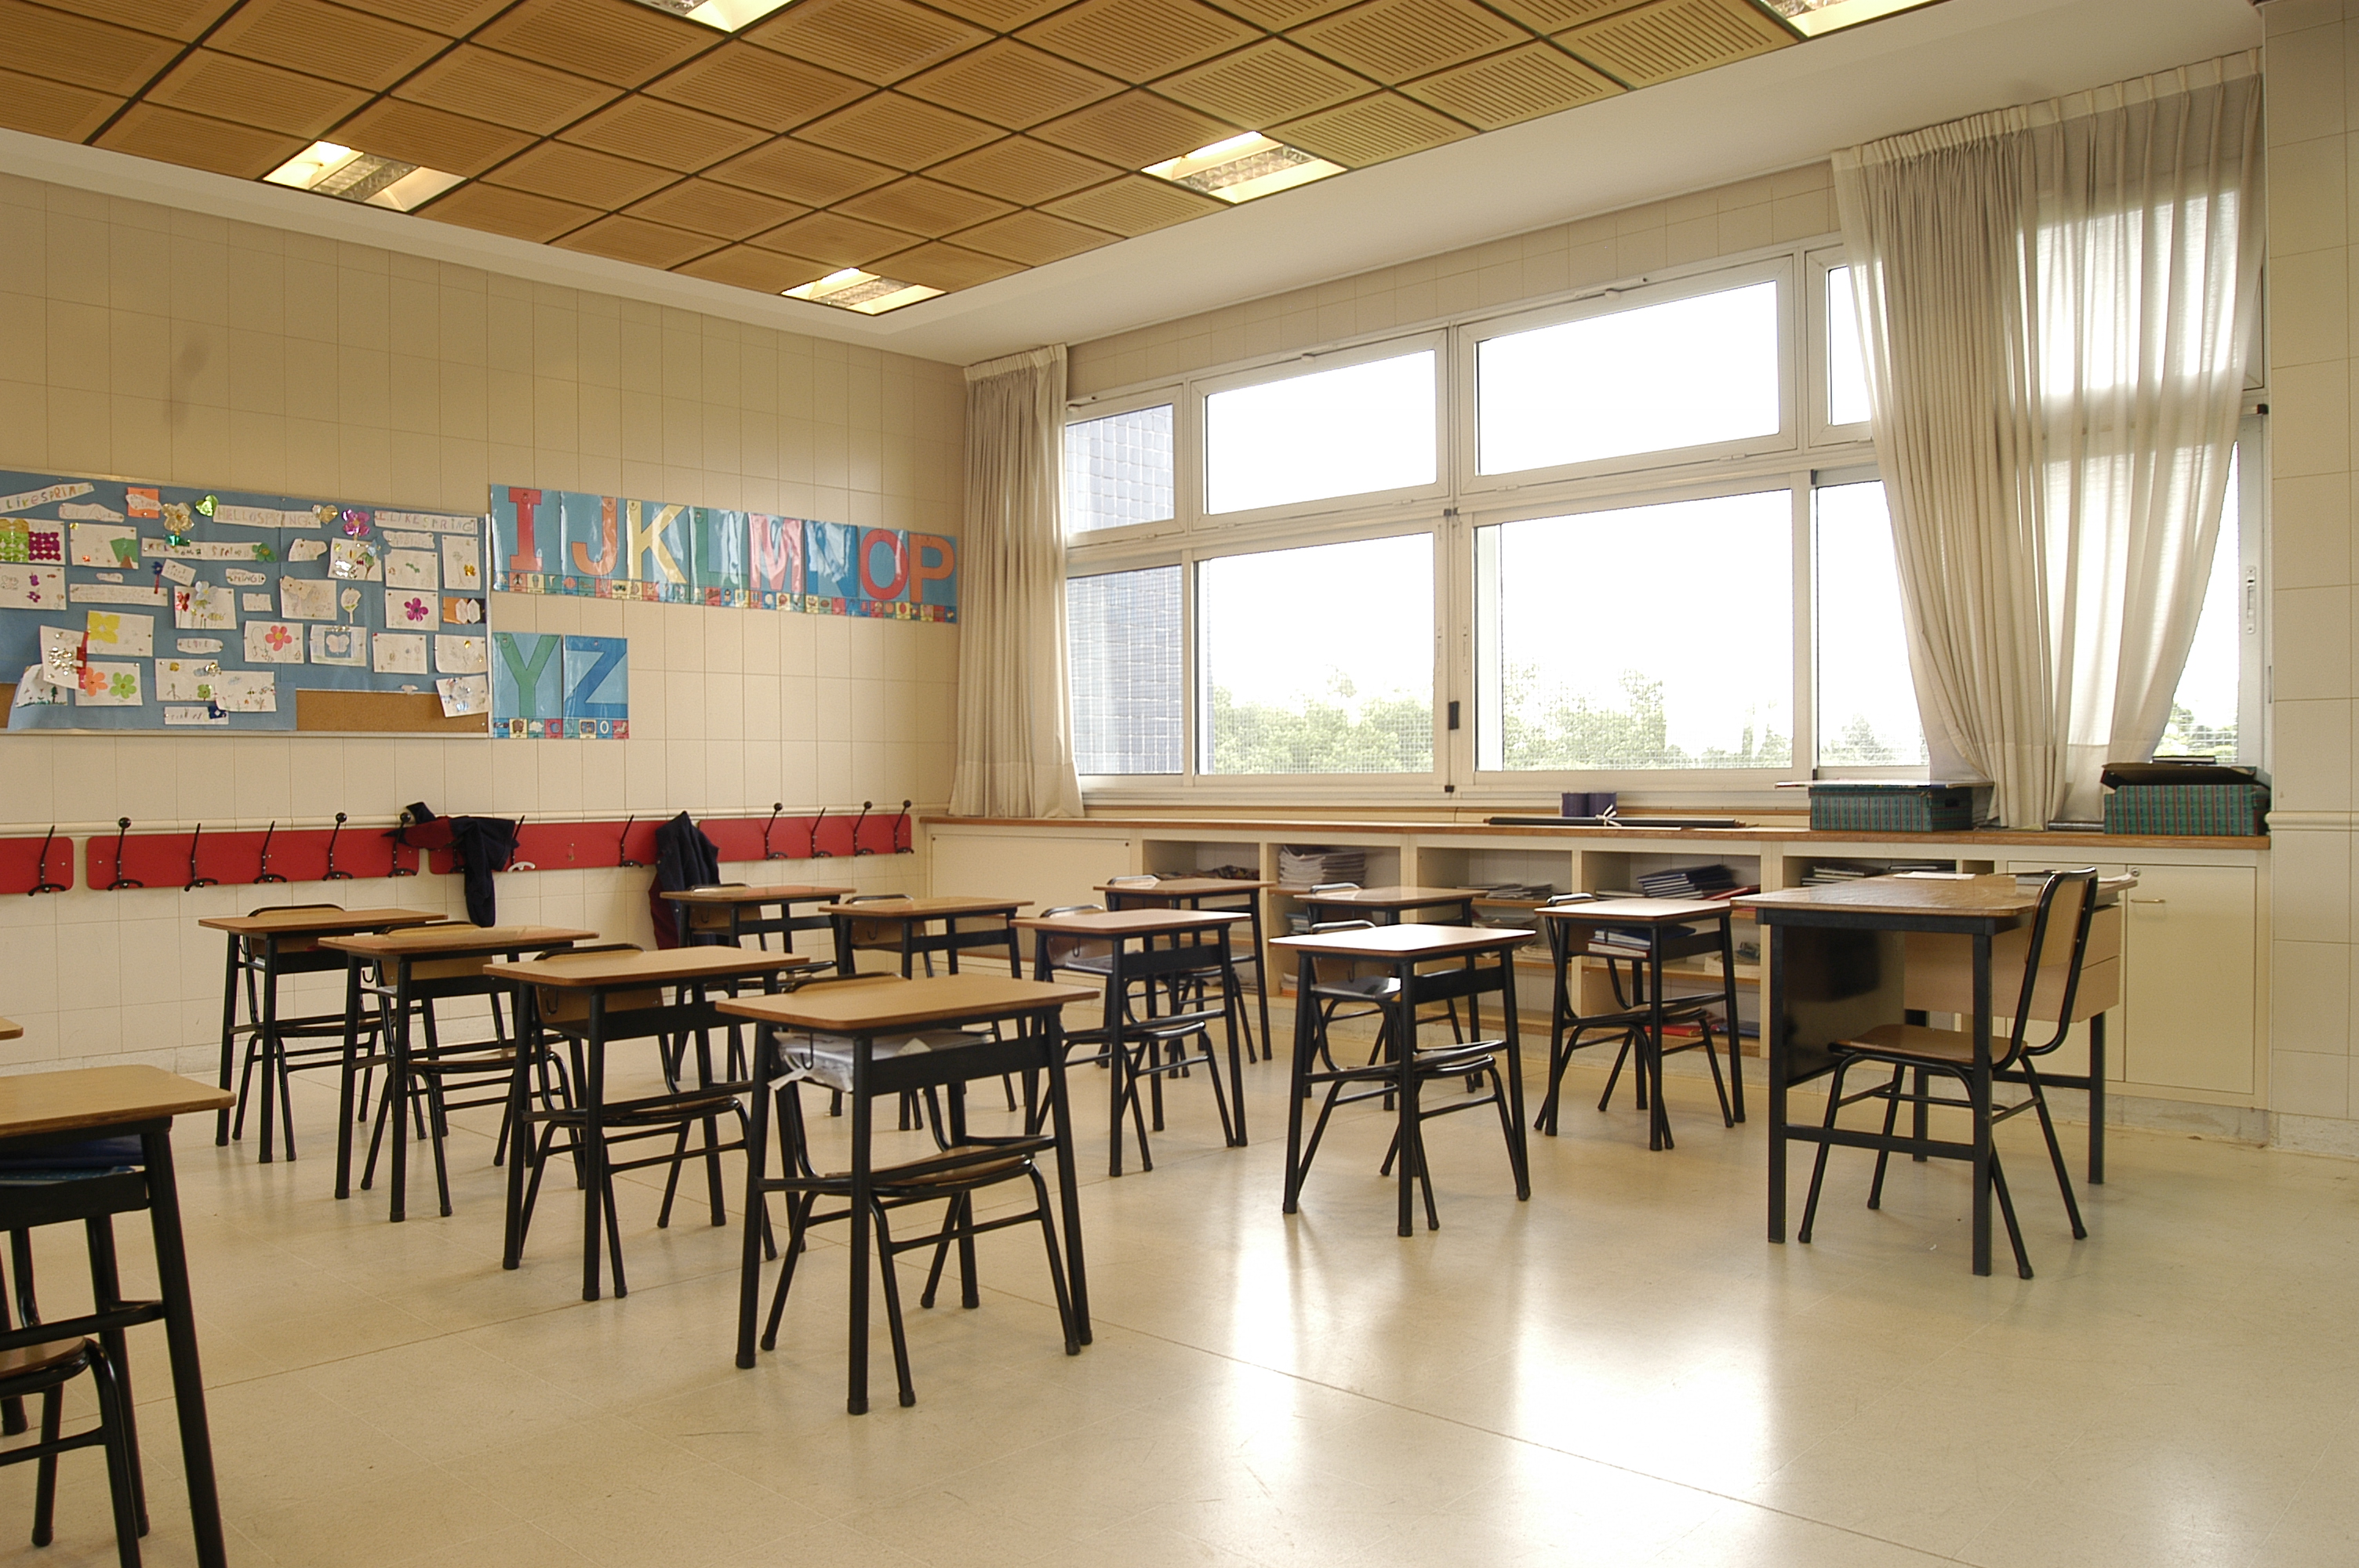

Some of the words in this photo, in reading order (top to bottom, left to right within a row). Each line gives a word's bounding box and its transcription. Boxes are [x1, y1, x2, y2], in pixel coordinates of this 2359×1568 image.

[507, 487, 542, 572] I
[571, 495, 618, 576] J
[627, 499, 689, 584] K
[748, 511, 803, 593] M
[805, 521, 858, 598] N
[860, 528, 910, 601] O
[907, 533, 955, 603] P
[493, 633, 561, 718] Y
[563, 635, 627, 718] Z
